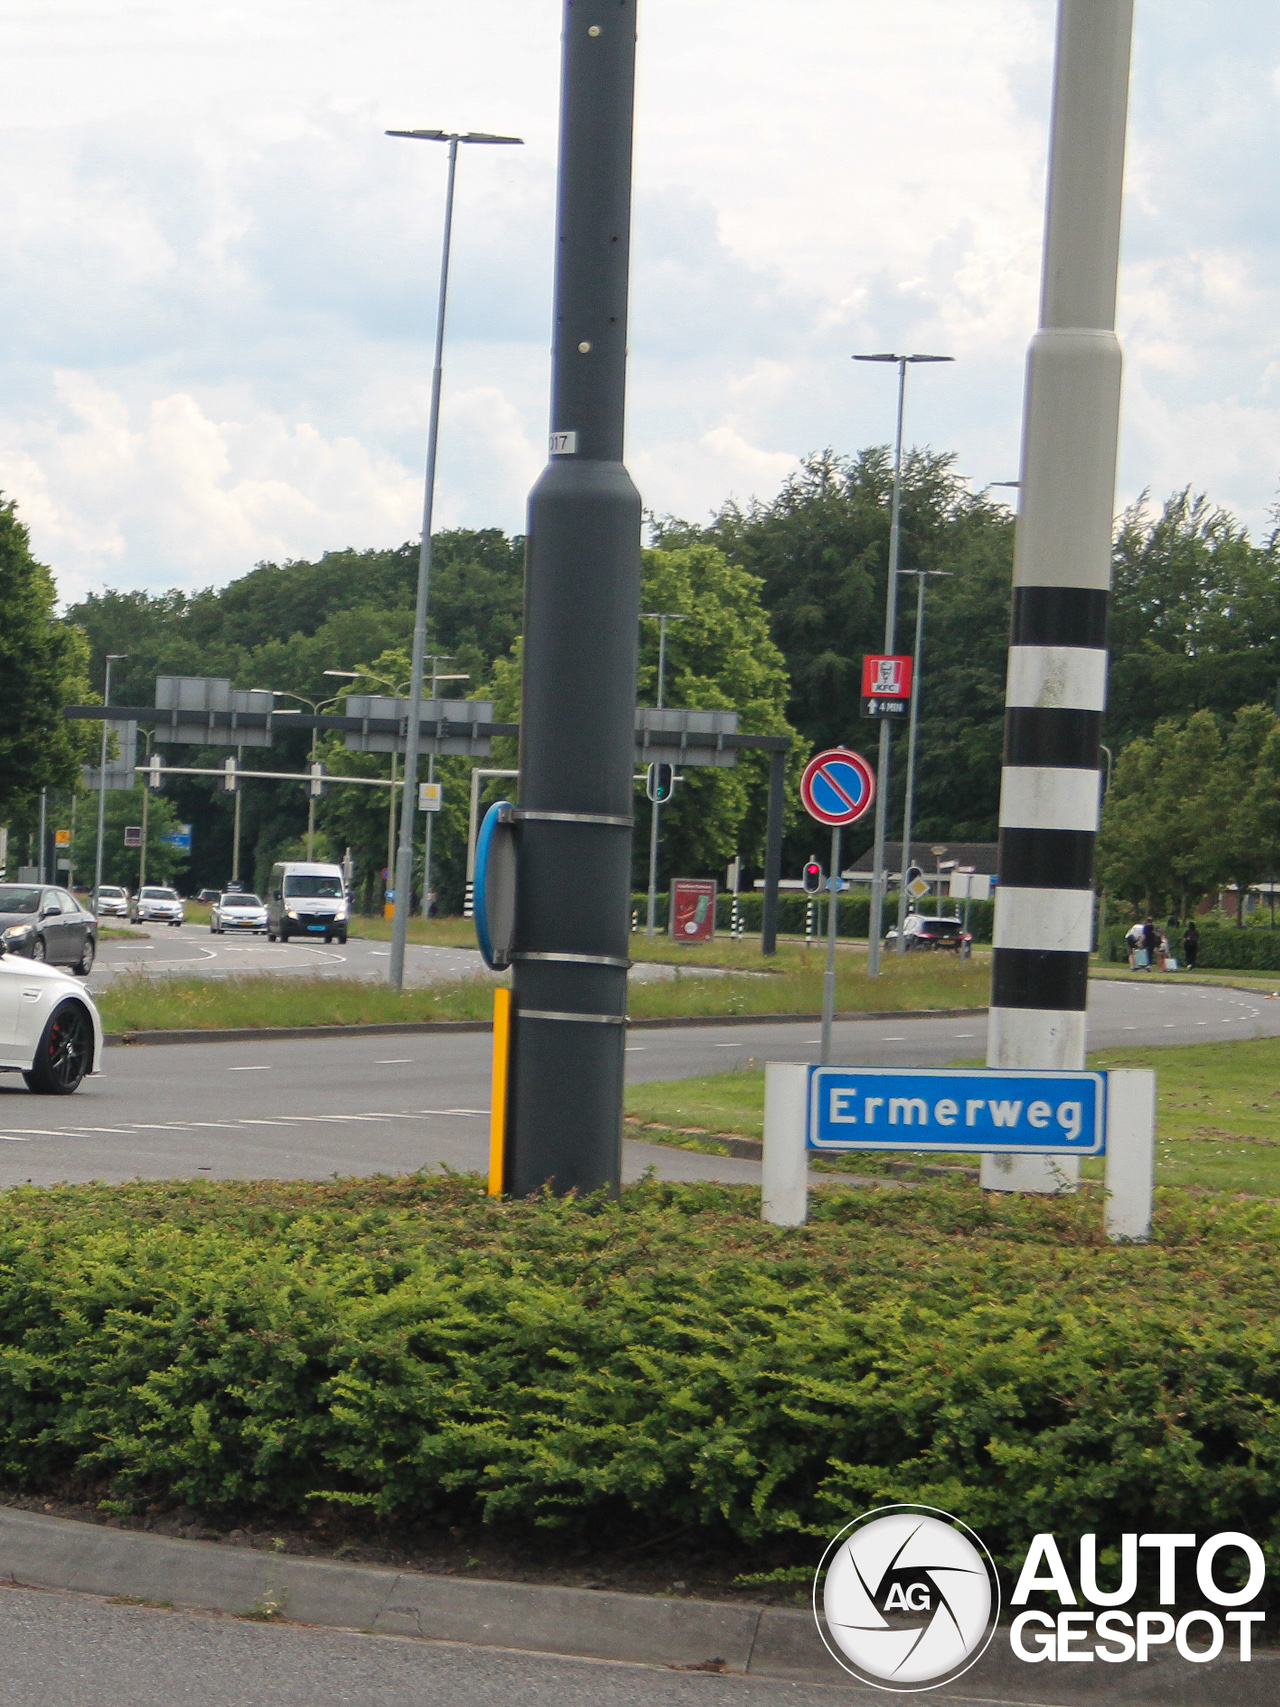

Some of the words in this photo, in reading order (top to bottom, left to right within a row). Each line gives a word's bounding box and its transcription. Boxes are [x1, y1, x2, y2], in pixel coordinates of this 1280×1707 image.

[876, 684, 895, 692] KFC
[879, 702, 886, 711] 4
[887, 702, 903, 712] MIN
[828, 1087, 1083, 1141] Ermerweg
